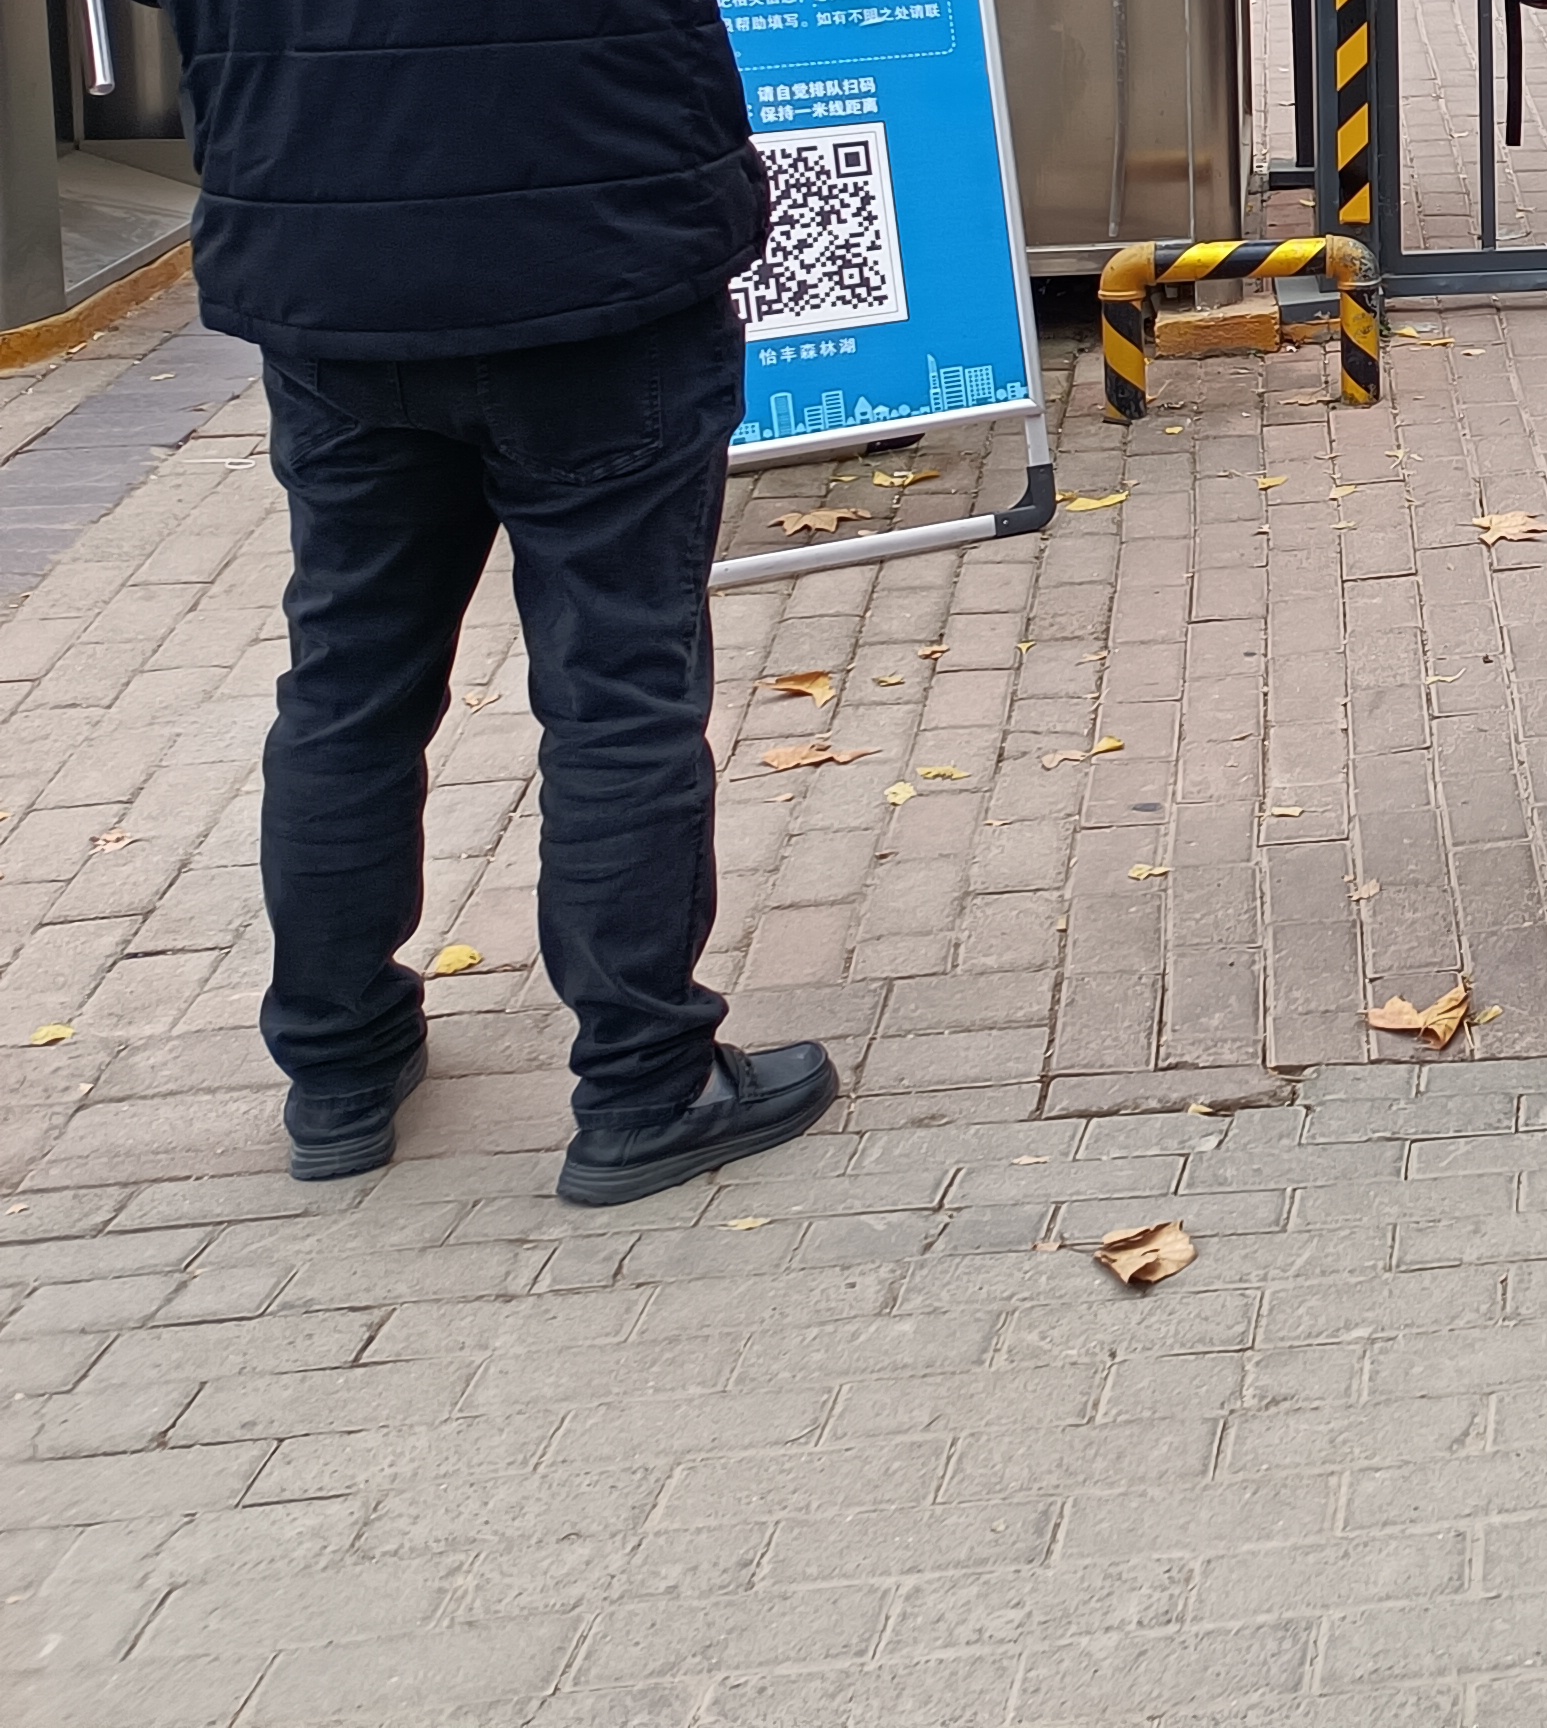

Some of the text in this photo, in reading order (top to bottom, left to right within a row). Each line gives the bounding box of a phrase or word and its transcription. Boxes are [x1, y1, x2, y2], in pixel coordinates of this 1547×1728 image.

[757, 77, 876, 102] 请自觉排队扫码
[760, 97, 879, 124] 保持一米线距离
